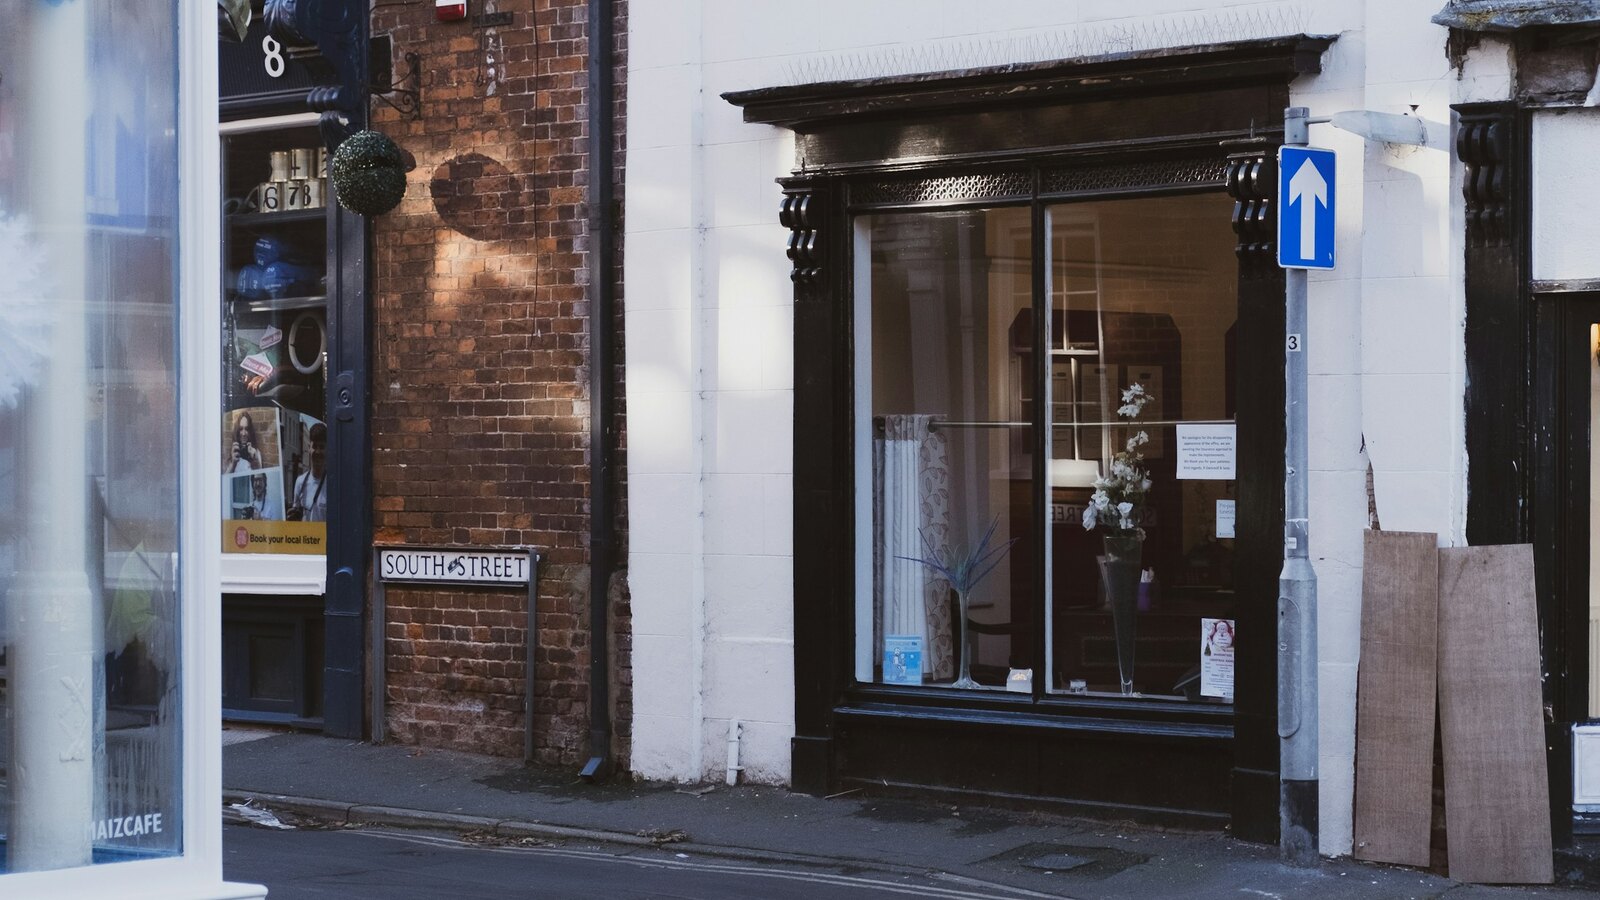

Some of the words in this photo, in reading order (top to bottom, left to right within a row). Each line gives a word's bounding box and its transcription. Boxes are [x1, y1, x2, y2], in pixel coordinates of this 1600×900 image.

[262, 35, 285, 78] 8
[263, 186, 278, 209] 6
[288, 186, 299, 206] 7
[1288, 335, 1298, 350] 3
[250, 533, 267, 543] Book
[268, 536, 284, 545] your
[285, 535, 301, 545] local
[302, 535, 320, 545] lister
[386, 554, 445, 576] SOUTH
[458, 556, 525, 578] STREET
